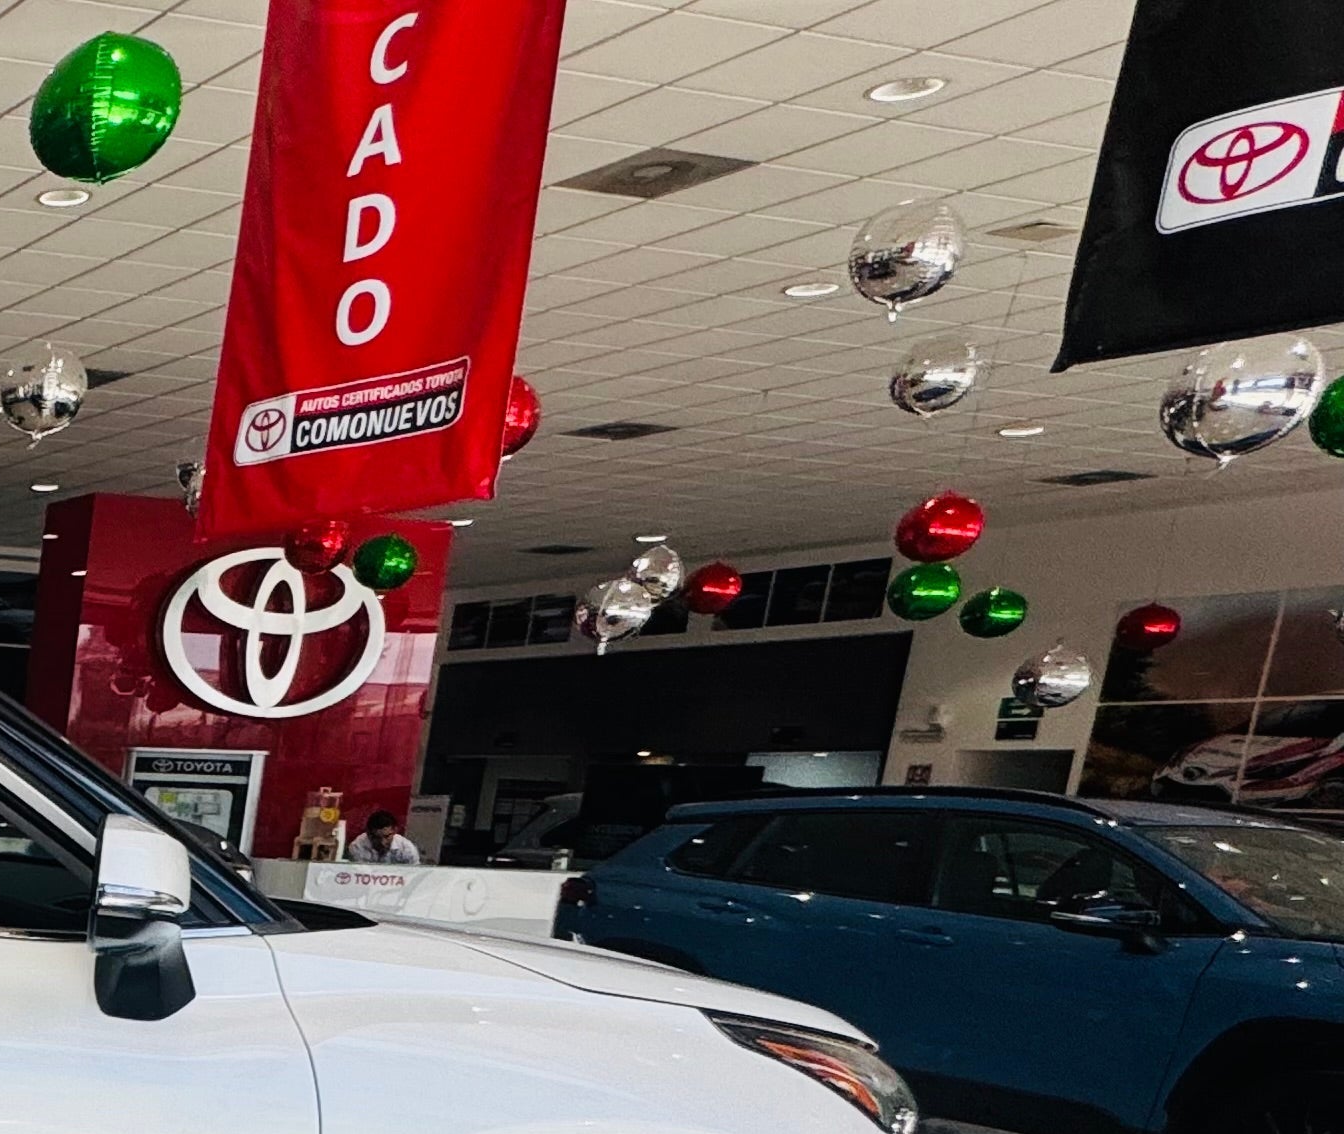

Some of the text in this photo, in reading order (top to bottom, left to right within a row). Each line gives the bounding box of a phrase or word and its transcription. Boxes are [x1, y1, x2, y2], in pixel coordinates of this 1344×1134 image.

[300, 368, 464, 412] AUTOS CERTIFICADOS TOYOTA
[295, 390, 459, 447] COMONUEVOS
[175, 761, 232, 773] TOYOTA
[354, 872, 405, 887] TOYOTA
